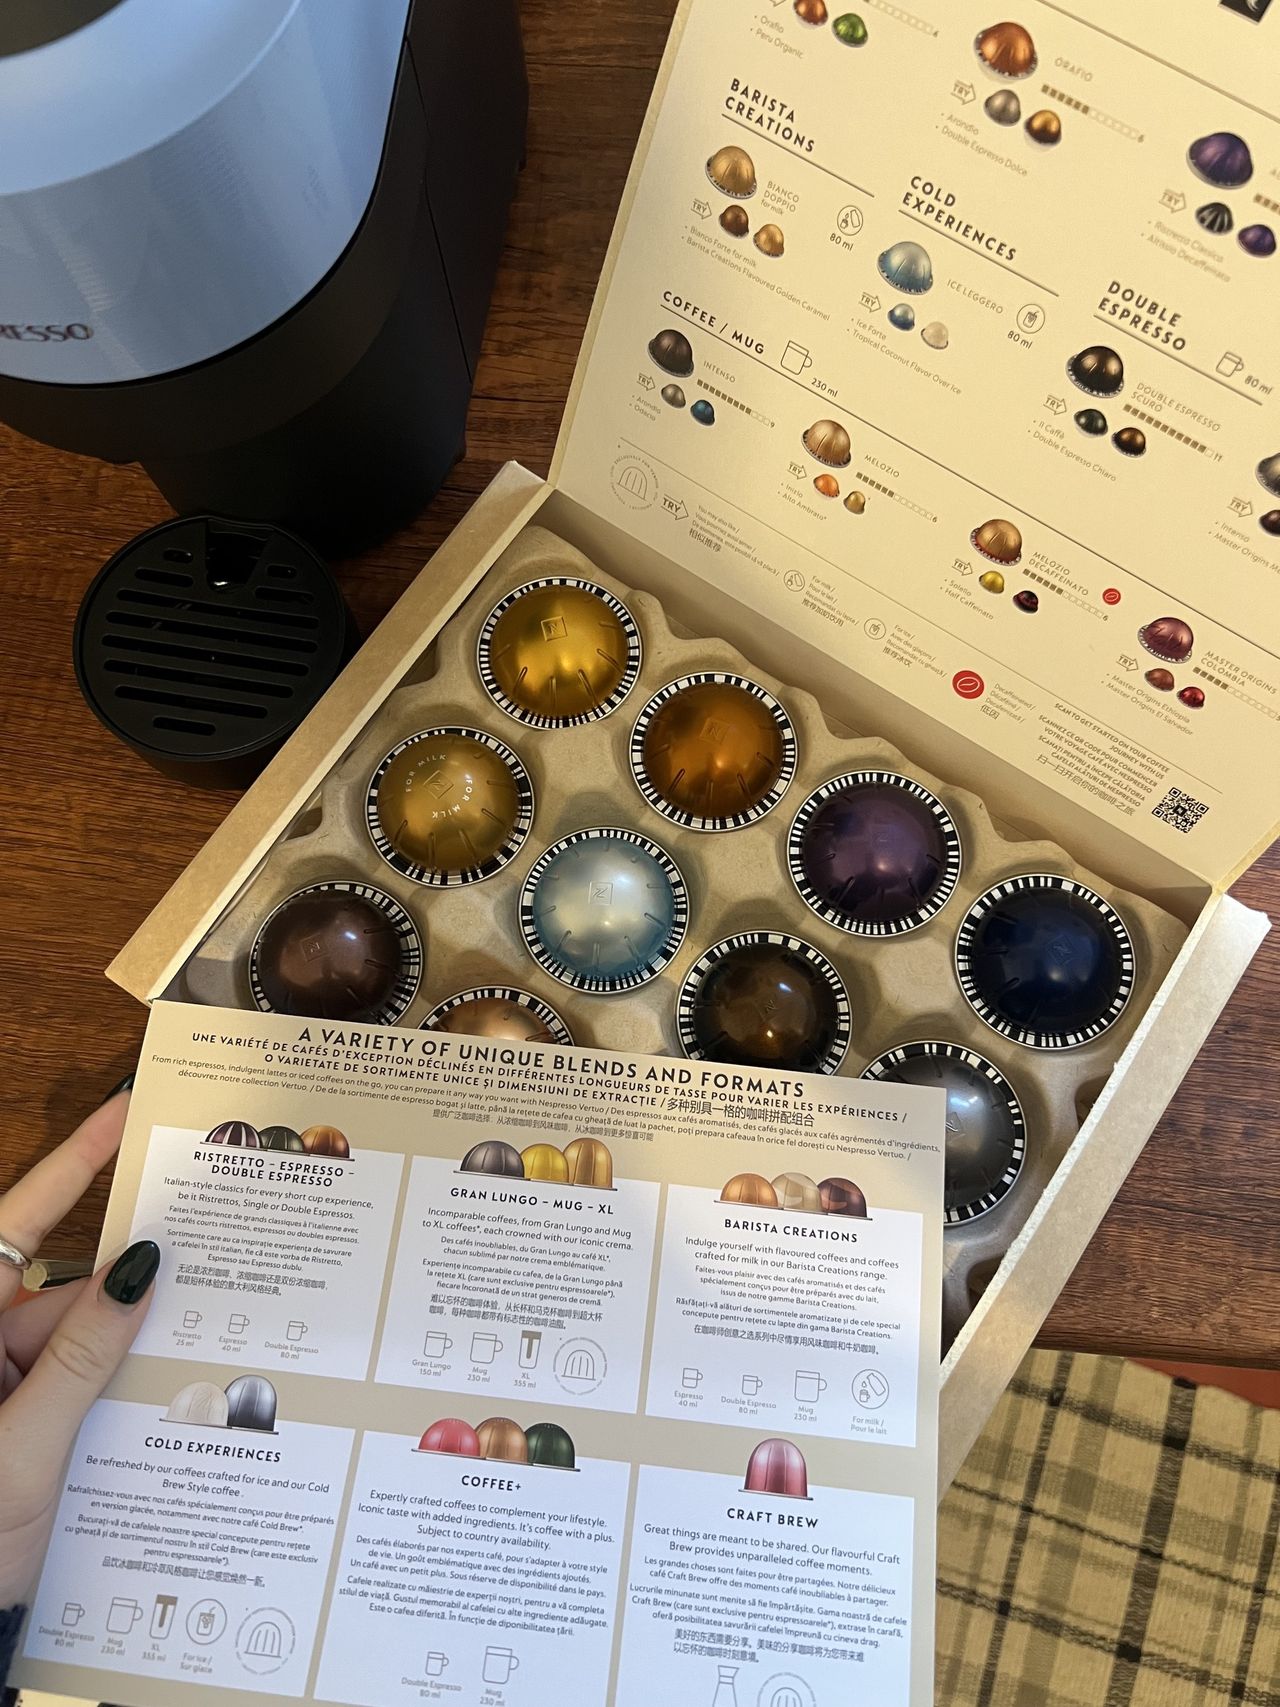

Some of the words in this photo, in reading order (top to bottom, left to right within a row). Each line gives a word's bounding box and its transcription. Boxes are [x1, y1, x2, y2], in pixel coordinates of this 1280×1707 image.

[730, 77, 794, 123] BARISTA
[725, 96, 814, 152] CREATIONS
[910, 175, 955, 207] COLD
[829, 232, 842, 244] 80
[841, 240, 853, 251] ml
[902, 191, 1016, 260] EXPERIENCES
[1107, 280, 1181, 327] DOUBLE
[662, 290, 716, 327] COFFEE
[731, 329, 764, 354] MUG
[1097, 297, 1186, 350] ESPRESSO
[1007, 329, 1020, 342] 80
[1019, 338, 1033, 349] ml
[810, 377, 827, 391] 230
[826, 387, 838, 397] ml
[1244, 374, 1259, 388] 80
[1258, 384, 1273, 395] ml
[462, 778, 473, 801] FOR
[432, 804, 461, 819] MILK
[192, 1032, 216, 1043] UNE
[220, 1035, 269, 1049] VARIÉTÉ
[272, 1041, 288, 1052] DE
[291, 1044, 328, 1056] CAFÉS
[332, 1048, 413, 1065] D'EXCEPTION
[417, 1058, 474, 1073] DÉCLINÉS
[478, 1064, 493, 1074] EN
[497, 1067, 574, 1084] DIFFÉRENTES
[578, 1076, 650, 1092] LONGUEURS
[654, 1084, 669, 1095] DE
[673, 1086, 707, 1099] TASSE
[710, 1091, 743, 1103] POUR
[747, 1095, 789, 1109] VARIER
[793, 1100, 813, 1111] LES
[817, 1103, 898, 1121] EXPÉRIENCES
[264, 1053, 273, 1062] O
[277, 1054, 339, 1070] VARIETATE
[343, 1062, 359, 1072] DE
[362, 1064, 439, 1081] SORTIMENTE
[442, 1073, 479, 1086] UNICE
[497, 1079, 568, 1096] DIMENSIUNI
[572, 1088, 588, 1098] DE
[297, 1026, 311, 1042] A
[321, 1028, 414, 1052] VARIETY
[421, 1040, 451, 1060] OF
[458, 1044, 544, 1068] UNIQUE
[552, 1054, 636, 1078] BLENDS
[644, 1065, 691, 1084] AND
[700, 1071, 803, 1097] FORMATS
[667, 1100, 815, 1128] 多种别具一格的咖啡拼配组合
[193, 1150, 264, 1168] RISTRETTO
[279, 1160, 343, 1177] ESPRESSO
[211, 1164, 264, 1179] DOUBLE
[268, 1170, 332, 1187] ESPRESSO
[163, 1176, 213, 1190] Italian-style
[213, 1182, 244, 1193] classics
[245, 1185, 259, 1195] for
[258, 1189, 283, 1200] every
[284, 1191, 306, 1201] short
[307, 1195, 323, 1204] cup
[324, 1196, 373, 1209] experience,
[450, 1187, 487, 1200] GRAN
[491, 1191, 537, 1206] LUNGO
[552, 1199, 582, 1211] MUG
[597, 1203, 613, 1215] XL
[427, 1207, 486, 1221] Incomparable
[486, 1214, 519, 1226] coffees,
[521, 1216, 542, 1227] from
[543, 1219, 564, 1230] Gran
[565, 1222, 593, 1235] Lungo
[593, 1226, 611, 1235] and
[611, 1228, 631, 1240] Mug
[724, 1218, 778, 1234] BARISTA
[782, 1225, 857, 1243] CREATIONS
[685, 1236, 718, 1249] Indulge
[718, 1241, 753, 1251] yourself
[754, 1245, 773, 1254] with
[775, 1246, 815, 1259] flavoured
[816, 1252, 848, 1263] coffees
[849, 1256, 866, 1265] and
[867, 1258, 899, 1269] coffees
[144, 1436, 182, 1450] COLD
[186, 1441, 281, 1462] EXPERIENCES
[369, 1488, 408, 1504] Expertly
[409, 1495, 442, 1507] crafted
[443, 1499, 476, 1511] coffees
[477, 1503, 488, 1512] to
[488, 1506, 546, 1520] complement
[547, 1513, 568, 1522] your
[569, 1513, 606, 1528] lifestyle.
[726, 1507, 772, 1523] CRAFT
[777, 1513, 818, 1528] BREW
[416, 1523, 451, 1538] Subject
[452, 1529, 463, 1539] to
[463, 1531, 499, 1545] country
[500, 1536, 551, 1551] availability.
[643, 1522, 670, 1535] Great
[671, 1526, 700, 1541] things
[701, 1532, 717, 1541] are
[718, 1534, 748, 1545] meant
[750, 1537, 760, 1547] to
[761, 1537, 774, 1548] be
[775, 1539, 809, 1552] shared.
[811, 1544, 829, 1555] Our
[831, 1546, 875, 1561] flavourful
[876, 1552, 900, 1564] Craft
